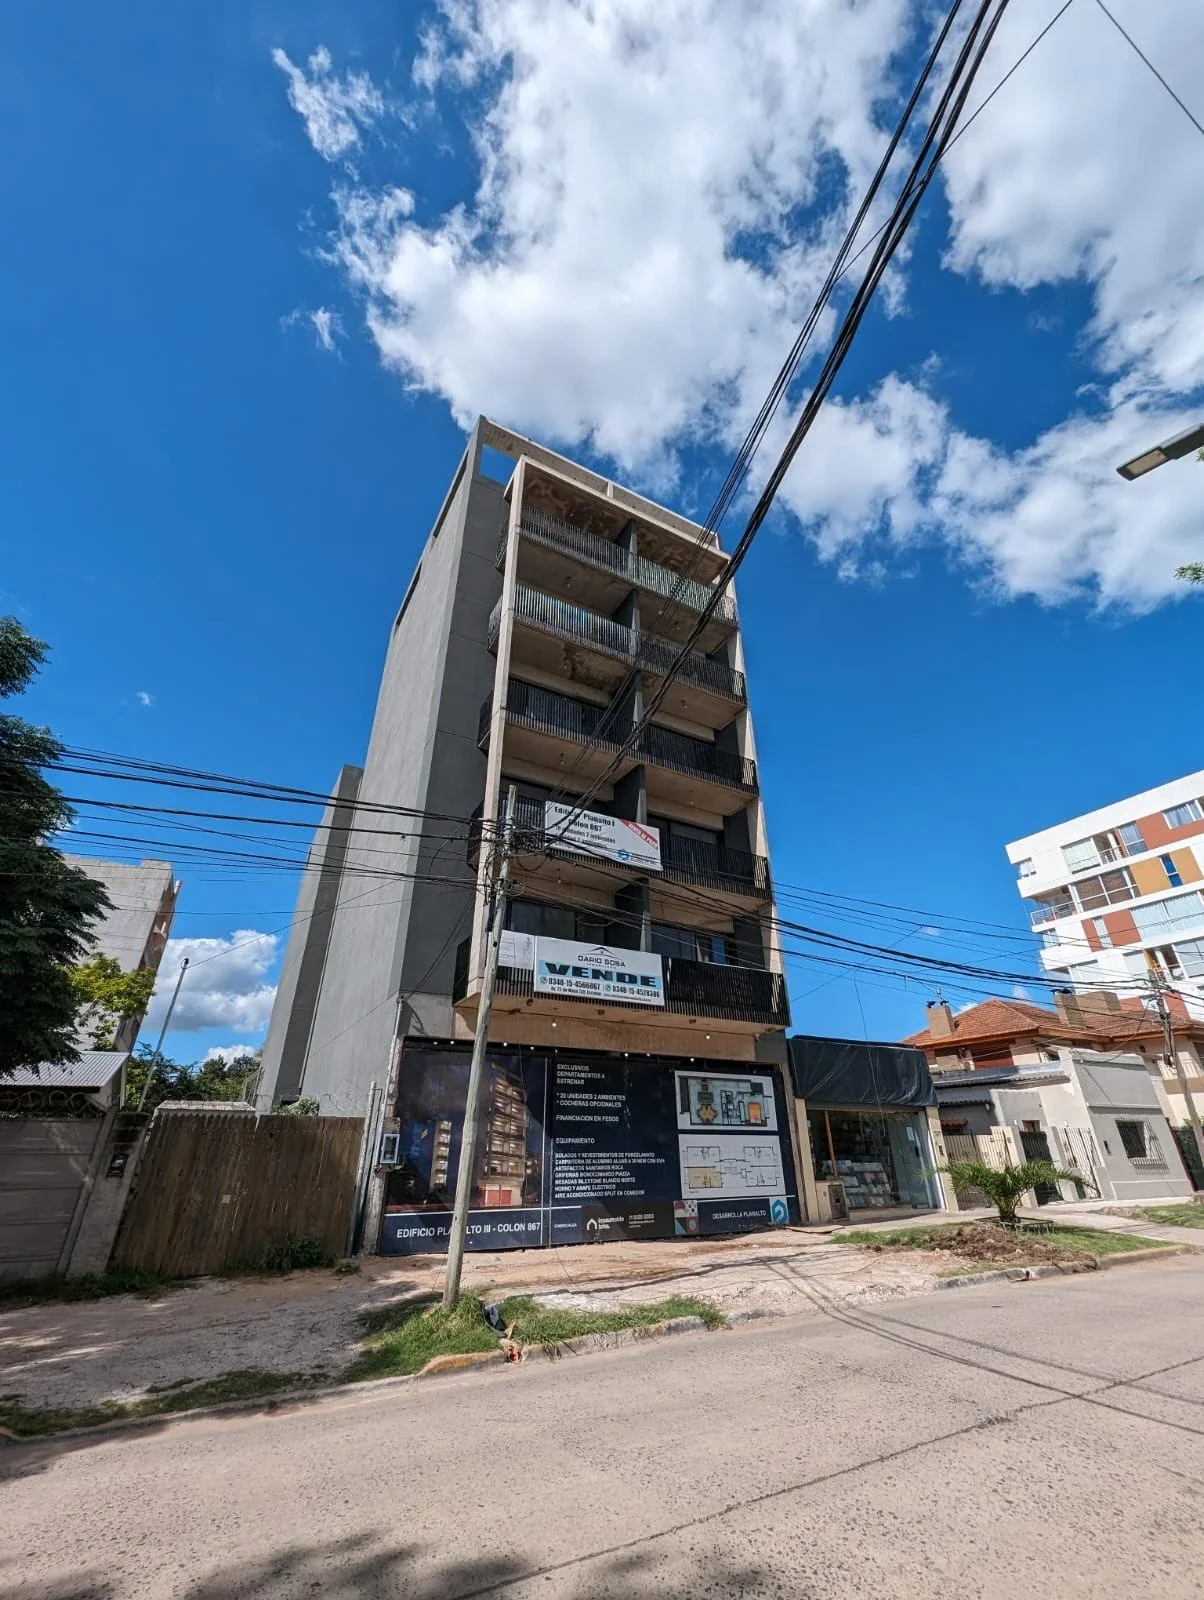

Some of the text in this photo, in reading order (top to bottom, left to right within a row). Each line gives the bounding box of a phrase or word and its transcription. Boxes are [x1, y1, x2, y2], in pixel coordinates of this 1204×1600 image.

[555, 806, 581, 817] Edifii
[583, 813, 611, 826] Planalto
[577, 955, 602, 964] DARIO
[604, 959, 626, 967] SOSA
[545, 962, 656, 987] VENDE
[557, 1071, 601, 1079] DEPARTAMENTOS
[712, 1212, 743, 1220] DESARROLLA
[396, 1226, 436, 1238] EDIFICIO
[437, 1225, 482, 1236] PLLTO
[483, 1224, 491, 1233] III
[497, 1223, 526, 1232] COLON
[527, 1222, 541, 1231] 867
